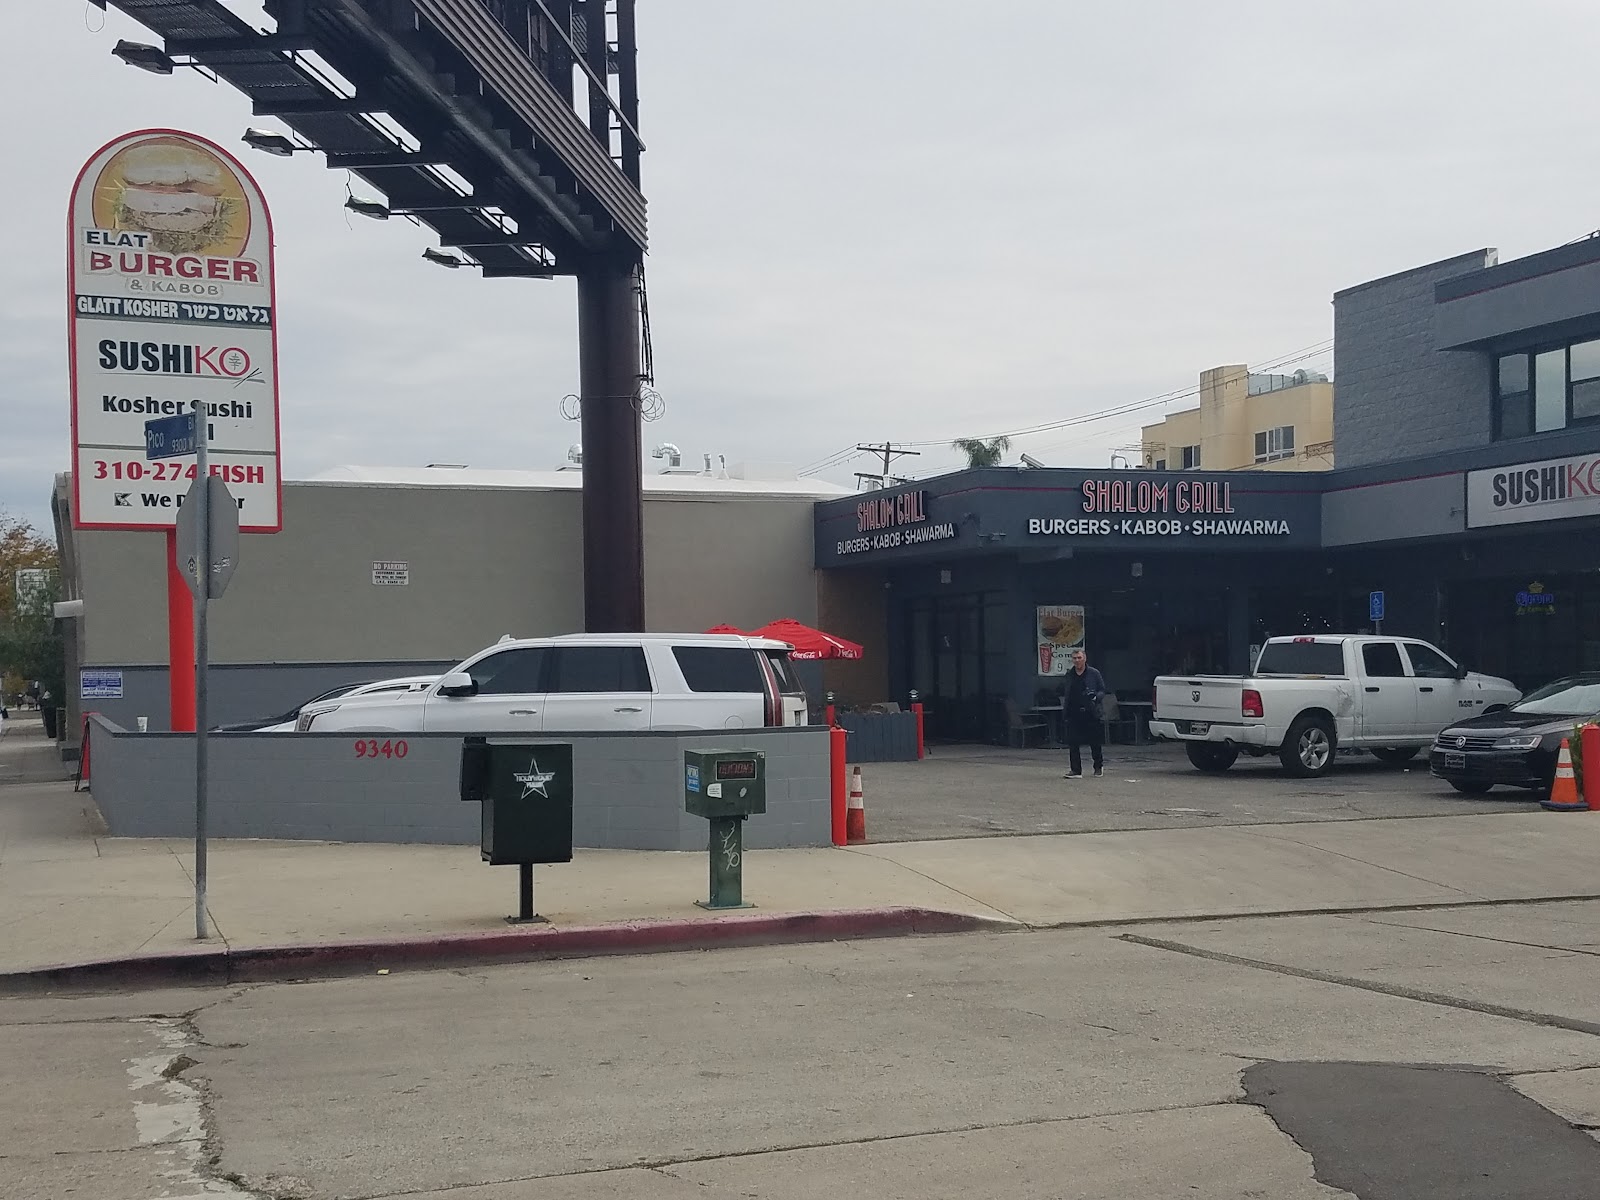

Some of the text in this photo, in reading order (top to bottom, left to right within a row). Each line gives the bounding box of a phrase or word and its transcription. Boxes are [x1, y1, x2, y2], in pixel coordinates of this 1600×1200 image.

[86, 231, 148, 247] ELAT
[90, 251, 259, 283] BURGER
[130, 279, 219, 296] & KABOB
[77, 297, 179, 318] GLATT KOSHER
[98, 339, 251, 377] SUSHIKO
[102, 395, 186, 415] Kosher
[147, 429, 165, 449] Pico
[93, 460, 264, 484] 310-274FISH
[141, 493, 171, 508] We
[1082, 479, 1235, 514] SHALOM GRILL
[857, 490, 926, 533] SHALOM GRILL
[1029, 519, 1290, 536] BURGERS KABOB SHAWARMA
[837, 522, 955, 555] BURGERS KABOB SHAWARMA
[1051, 651, 1073, 659] Com
[354, 739, 408, 759] 9340
